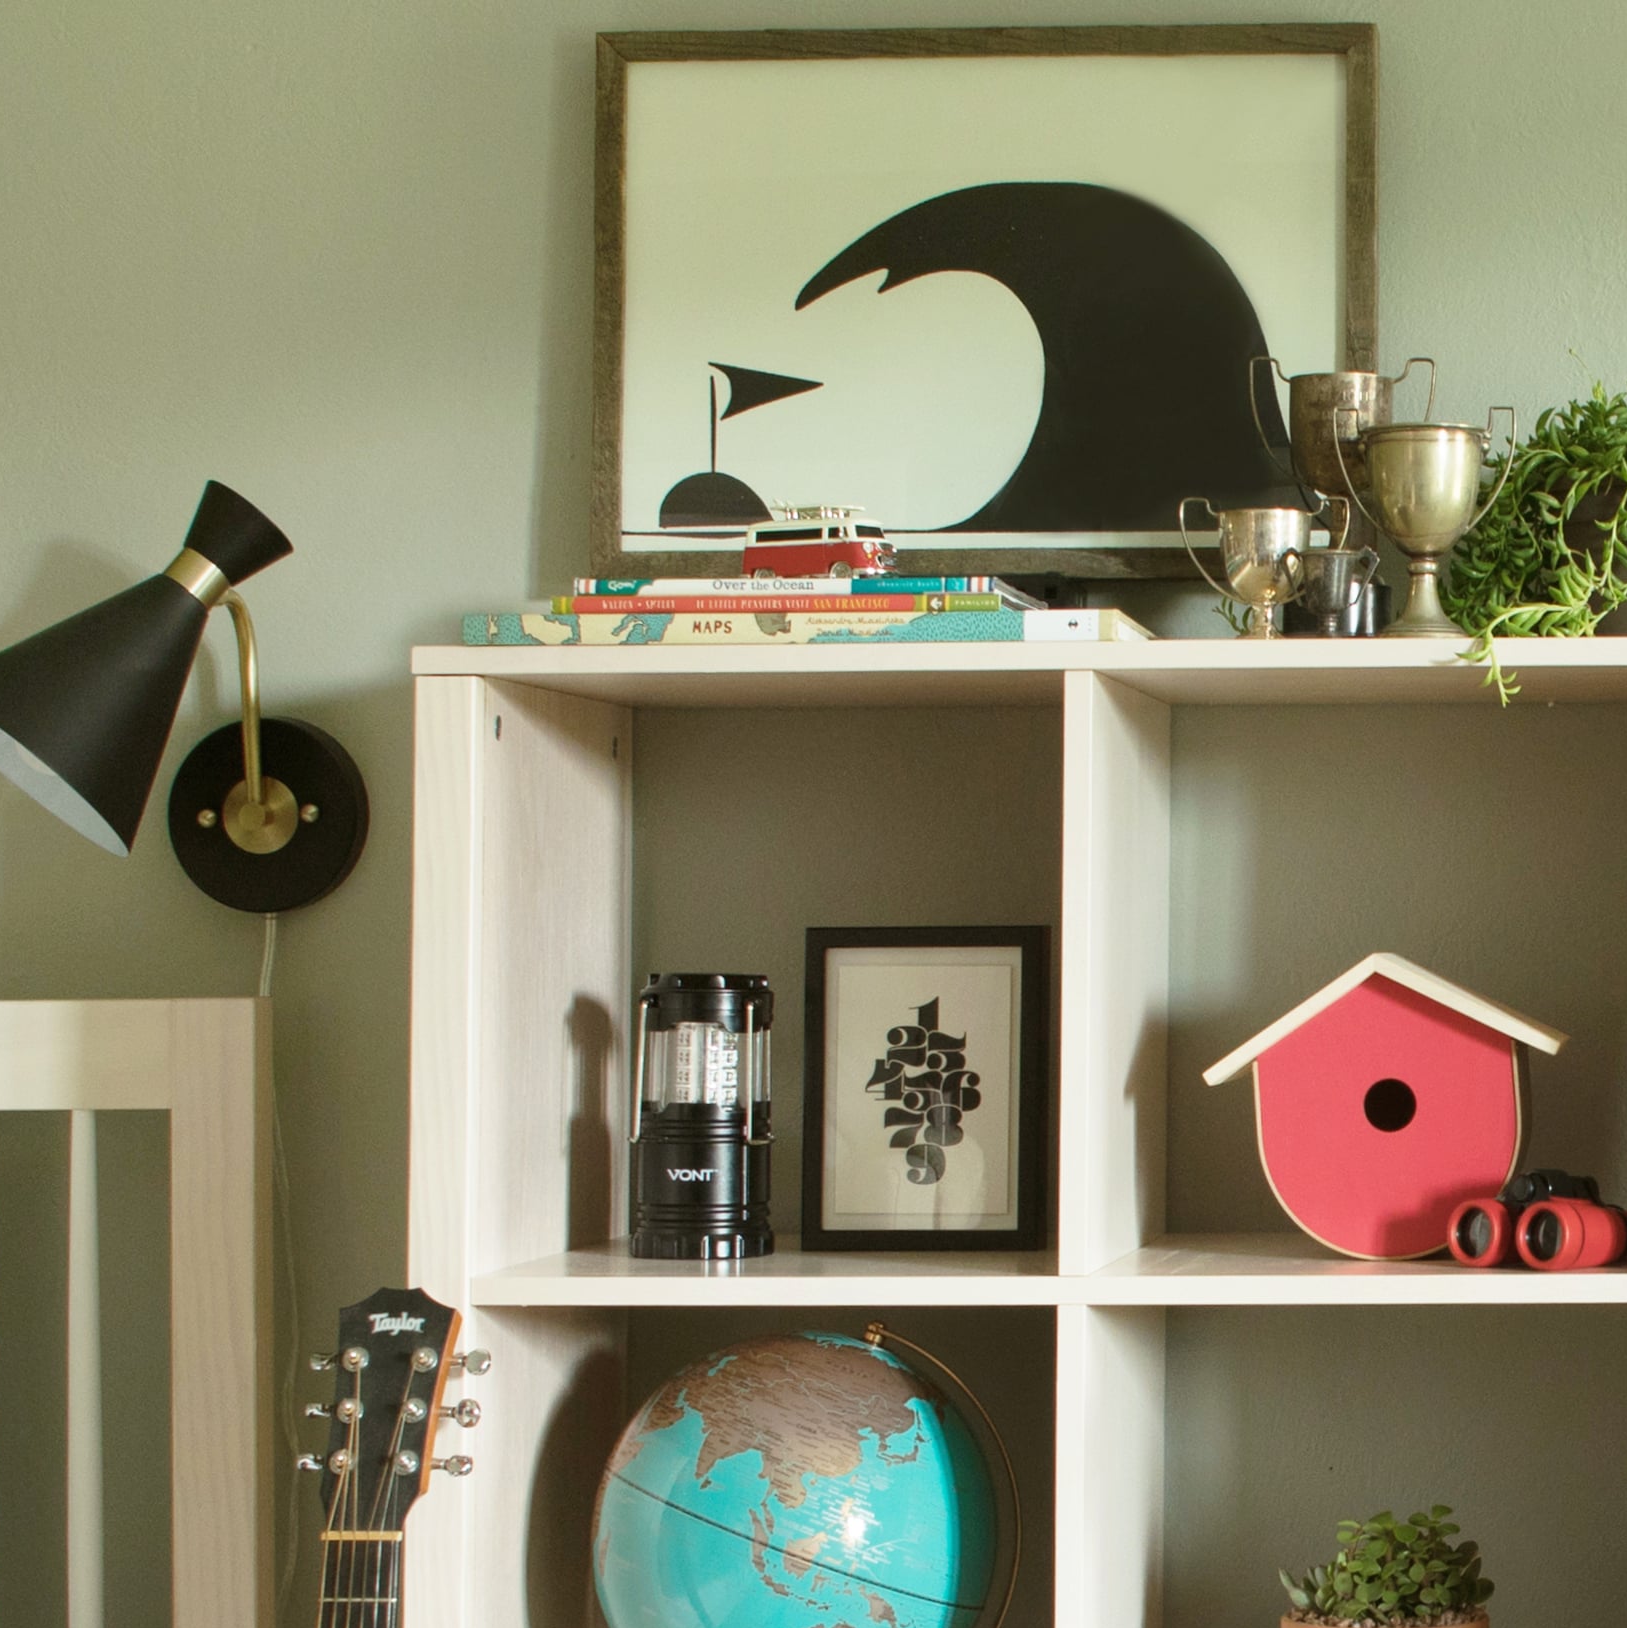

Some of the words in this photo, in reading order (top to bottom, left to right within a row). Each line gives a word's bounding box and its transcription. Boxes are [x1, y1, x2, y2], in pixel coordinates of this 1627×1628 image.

[712, 579, 746, 591] Over
[751, 580, 770, 591] the
[772, 579, 815, 591] Ocean
[813, 598, 833, 609] SAN
[835, 598, 890, 609] FRANCISCO
[691, 620, 733, 634] MAPS
[908, 995, 940, 1032] 1
[886, 1025, 927, 1068] 2
[865, 1059, 904, 1101] 4
[942, 1070, 982, 1112] 6
[884, 1106, 924, 1148] 7
[923, 1104, 965, 1147] 8
[666, 1168, 714, 1182] VONT
[905, 1143, 947, 1186] 9
[368, 1311, 426, 1337] Taylor
